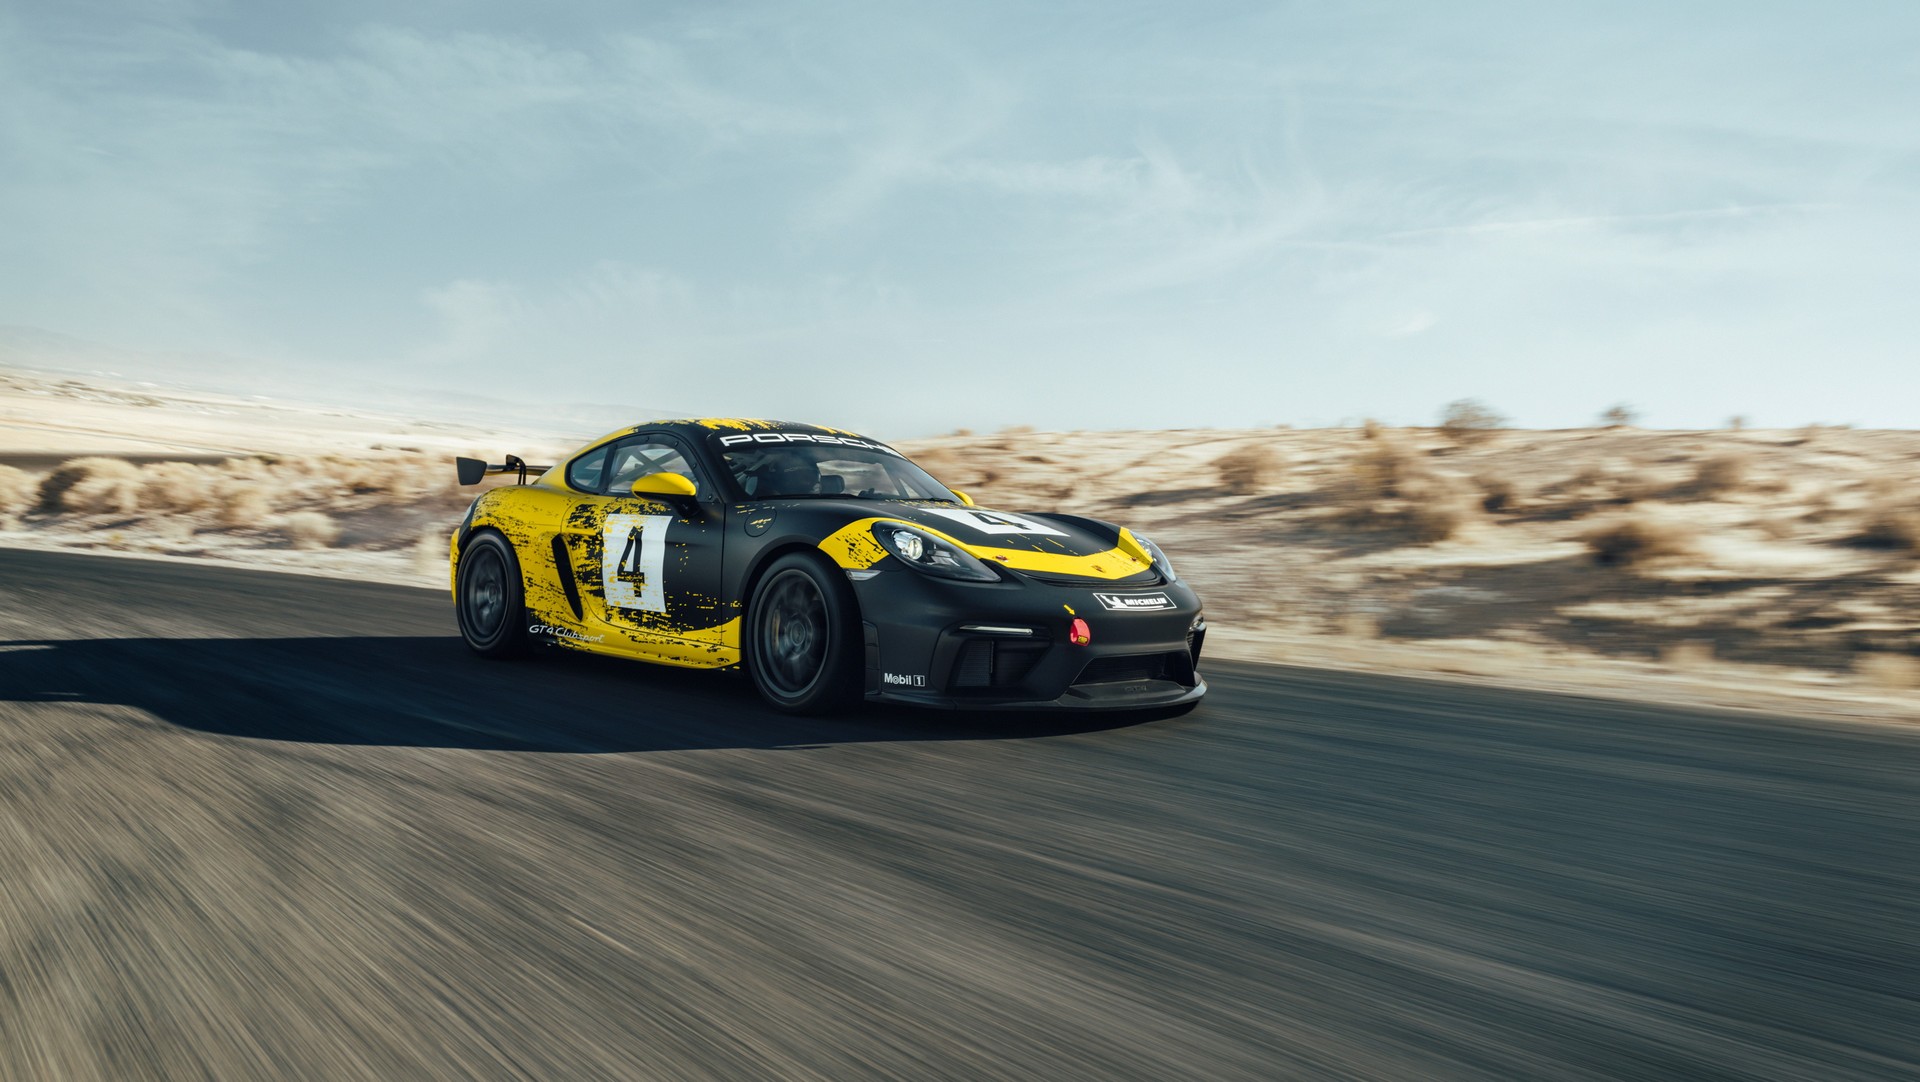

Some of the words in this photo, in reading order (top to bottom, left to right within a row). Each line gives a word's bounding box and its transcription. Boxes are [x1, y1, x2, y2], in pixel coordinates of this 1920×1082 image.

[968, 511, 1032, 530] 4
[616, 525, 646, 598] 4
[1124, 597, 1168, 606] MICHELIN
[555, 627, 605, 643] Clubsport
[884, 672, 912, 686] Mobil
